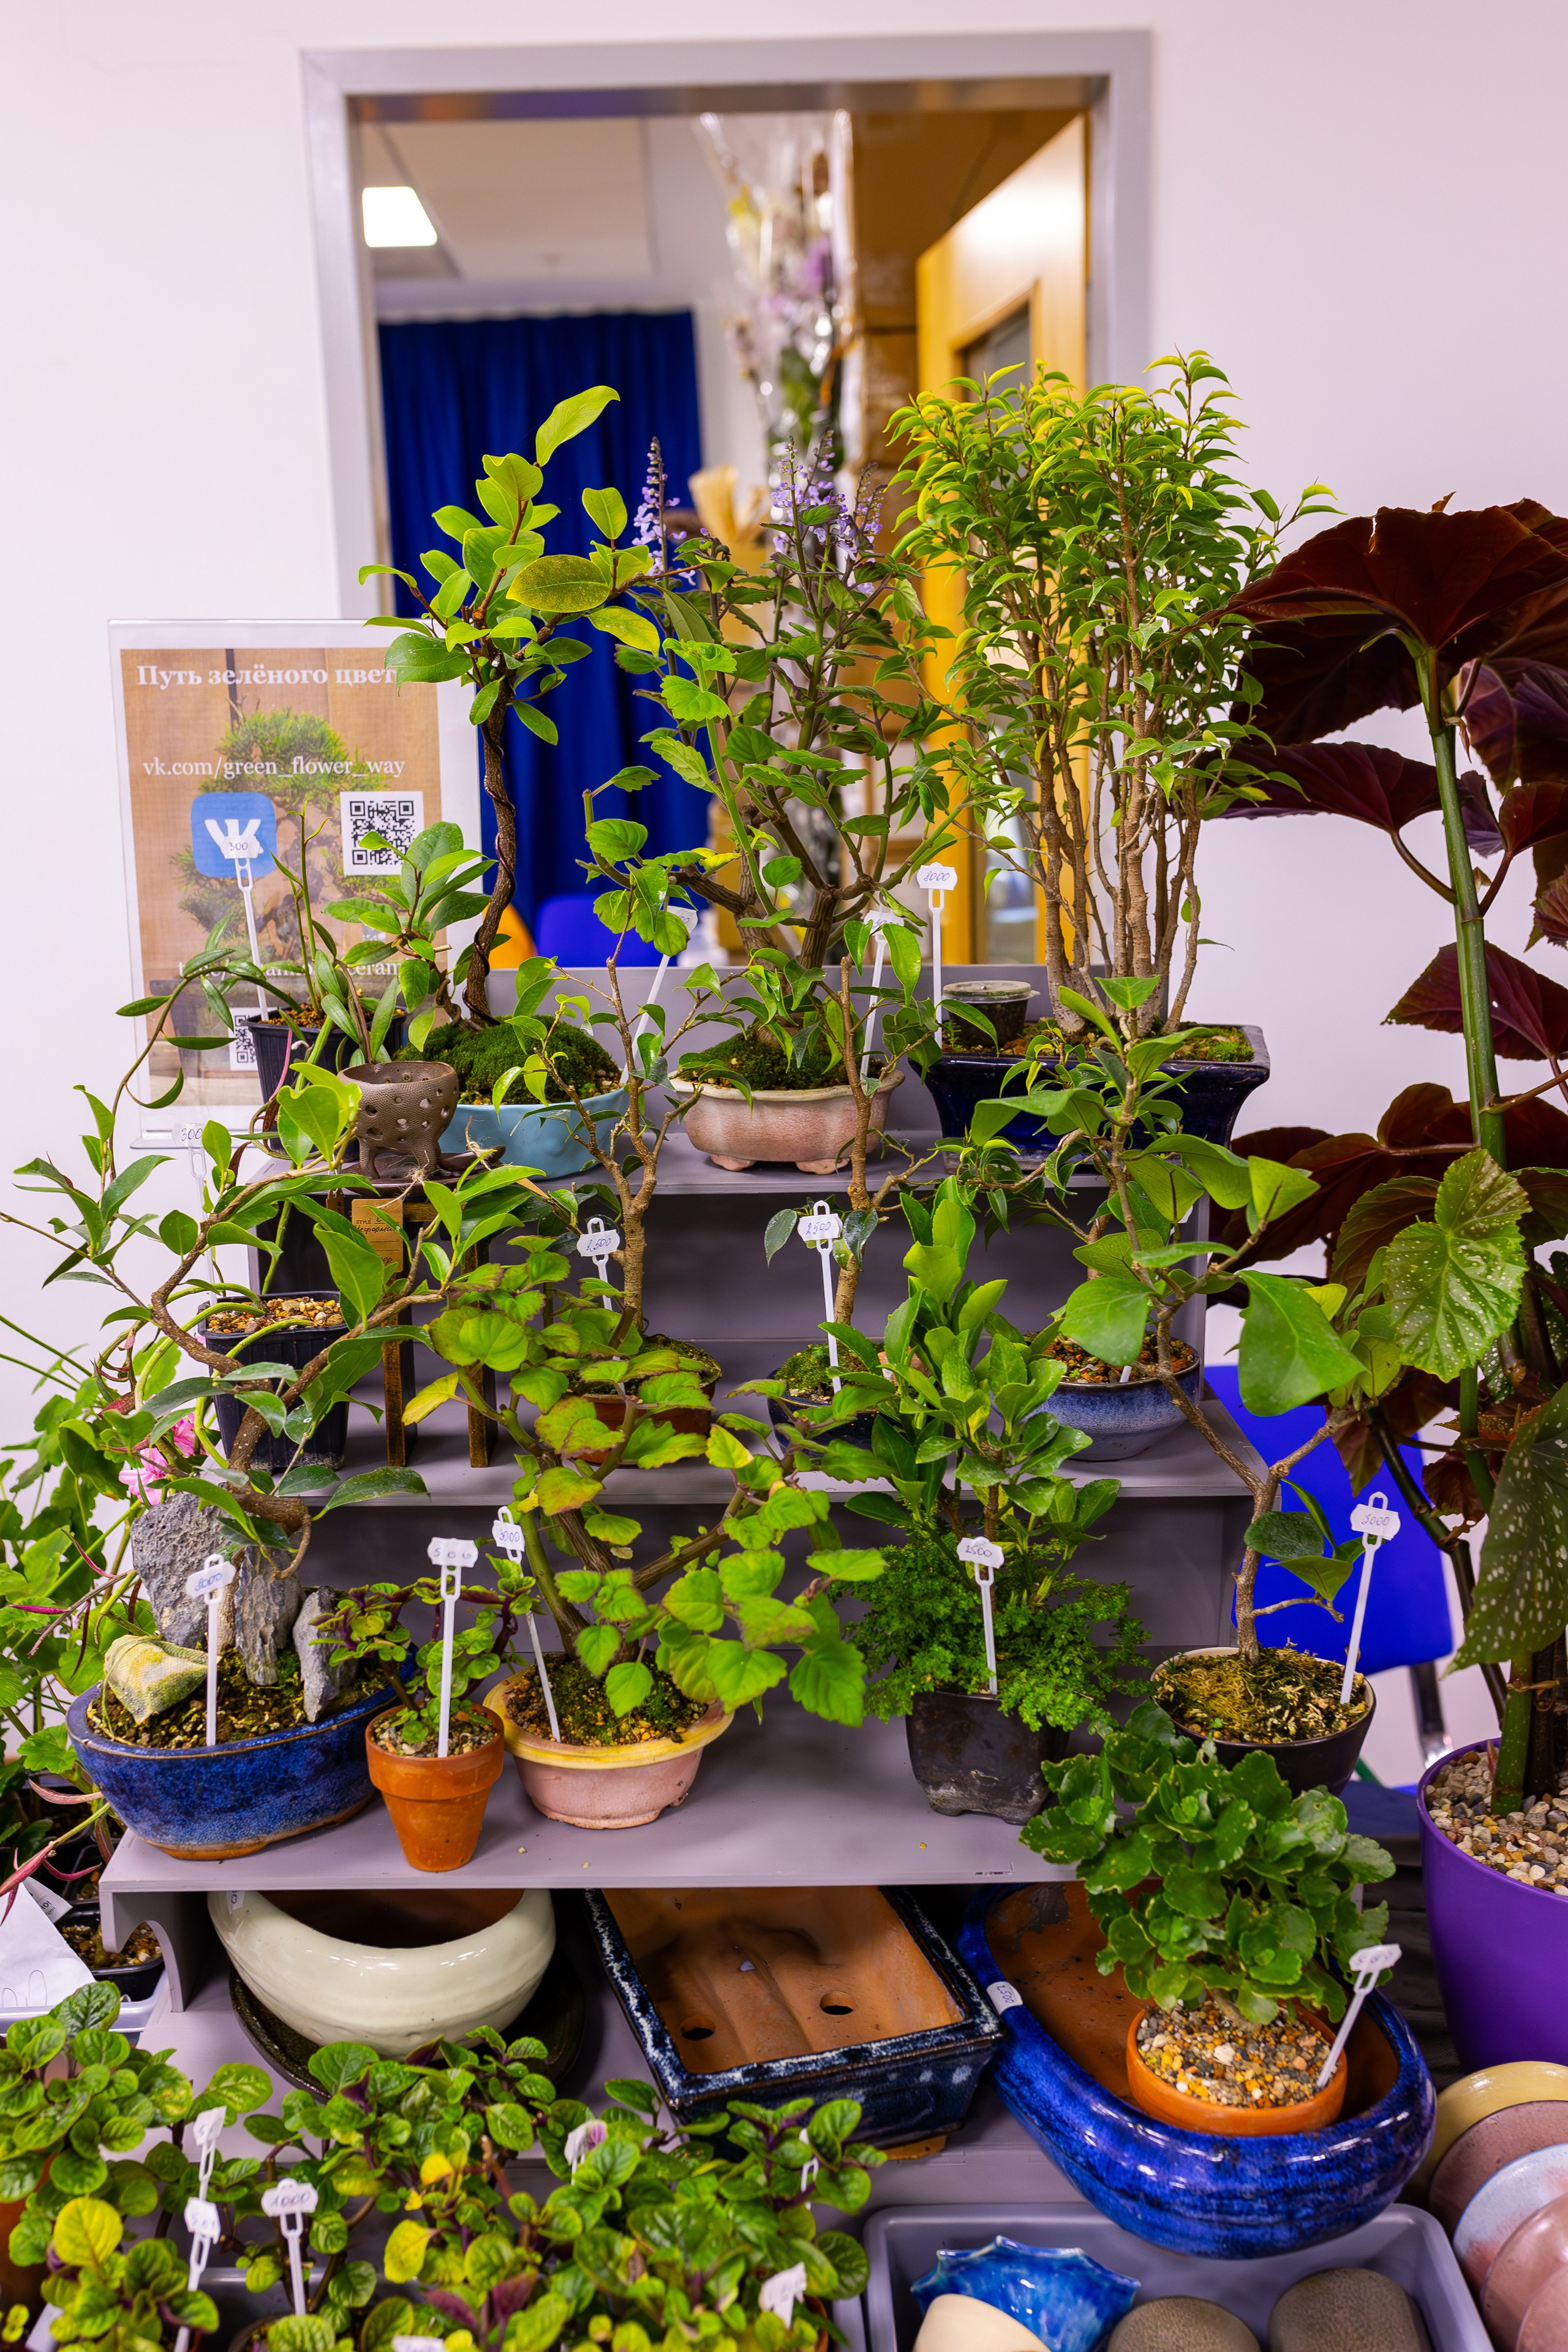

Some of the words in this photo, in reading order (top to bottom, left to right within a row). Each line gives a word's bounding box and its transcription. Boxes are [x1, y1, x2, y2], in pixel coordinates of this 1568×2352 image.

[137, 665, 203, 690] Путь
[208, 664, 328, 685] зелёного
[335, 668, 396, 687] цвет
[143, 756, 405, 778] vk.com/green_flower_way
[228, 842, 248, 851] 300
[181, 1128, 203, 1141] 300
[805, 1221, 831, 1235] 2500
[586, 1238, 611, 1251] 2500
[434, 1548, 472, 1559] 500
[965, 1545, 992, 1557] 2500
[997, 1985, 1014, 2003] 2500
[271, 2191, 311, 2205] 1000
